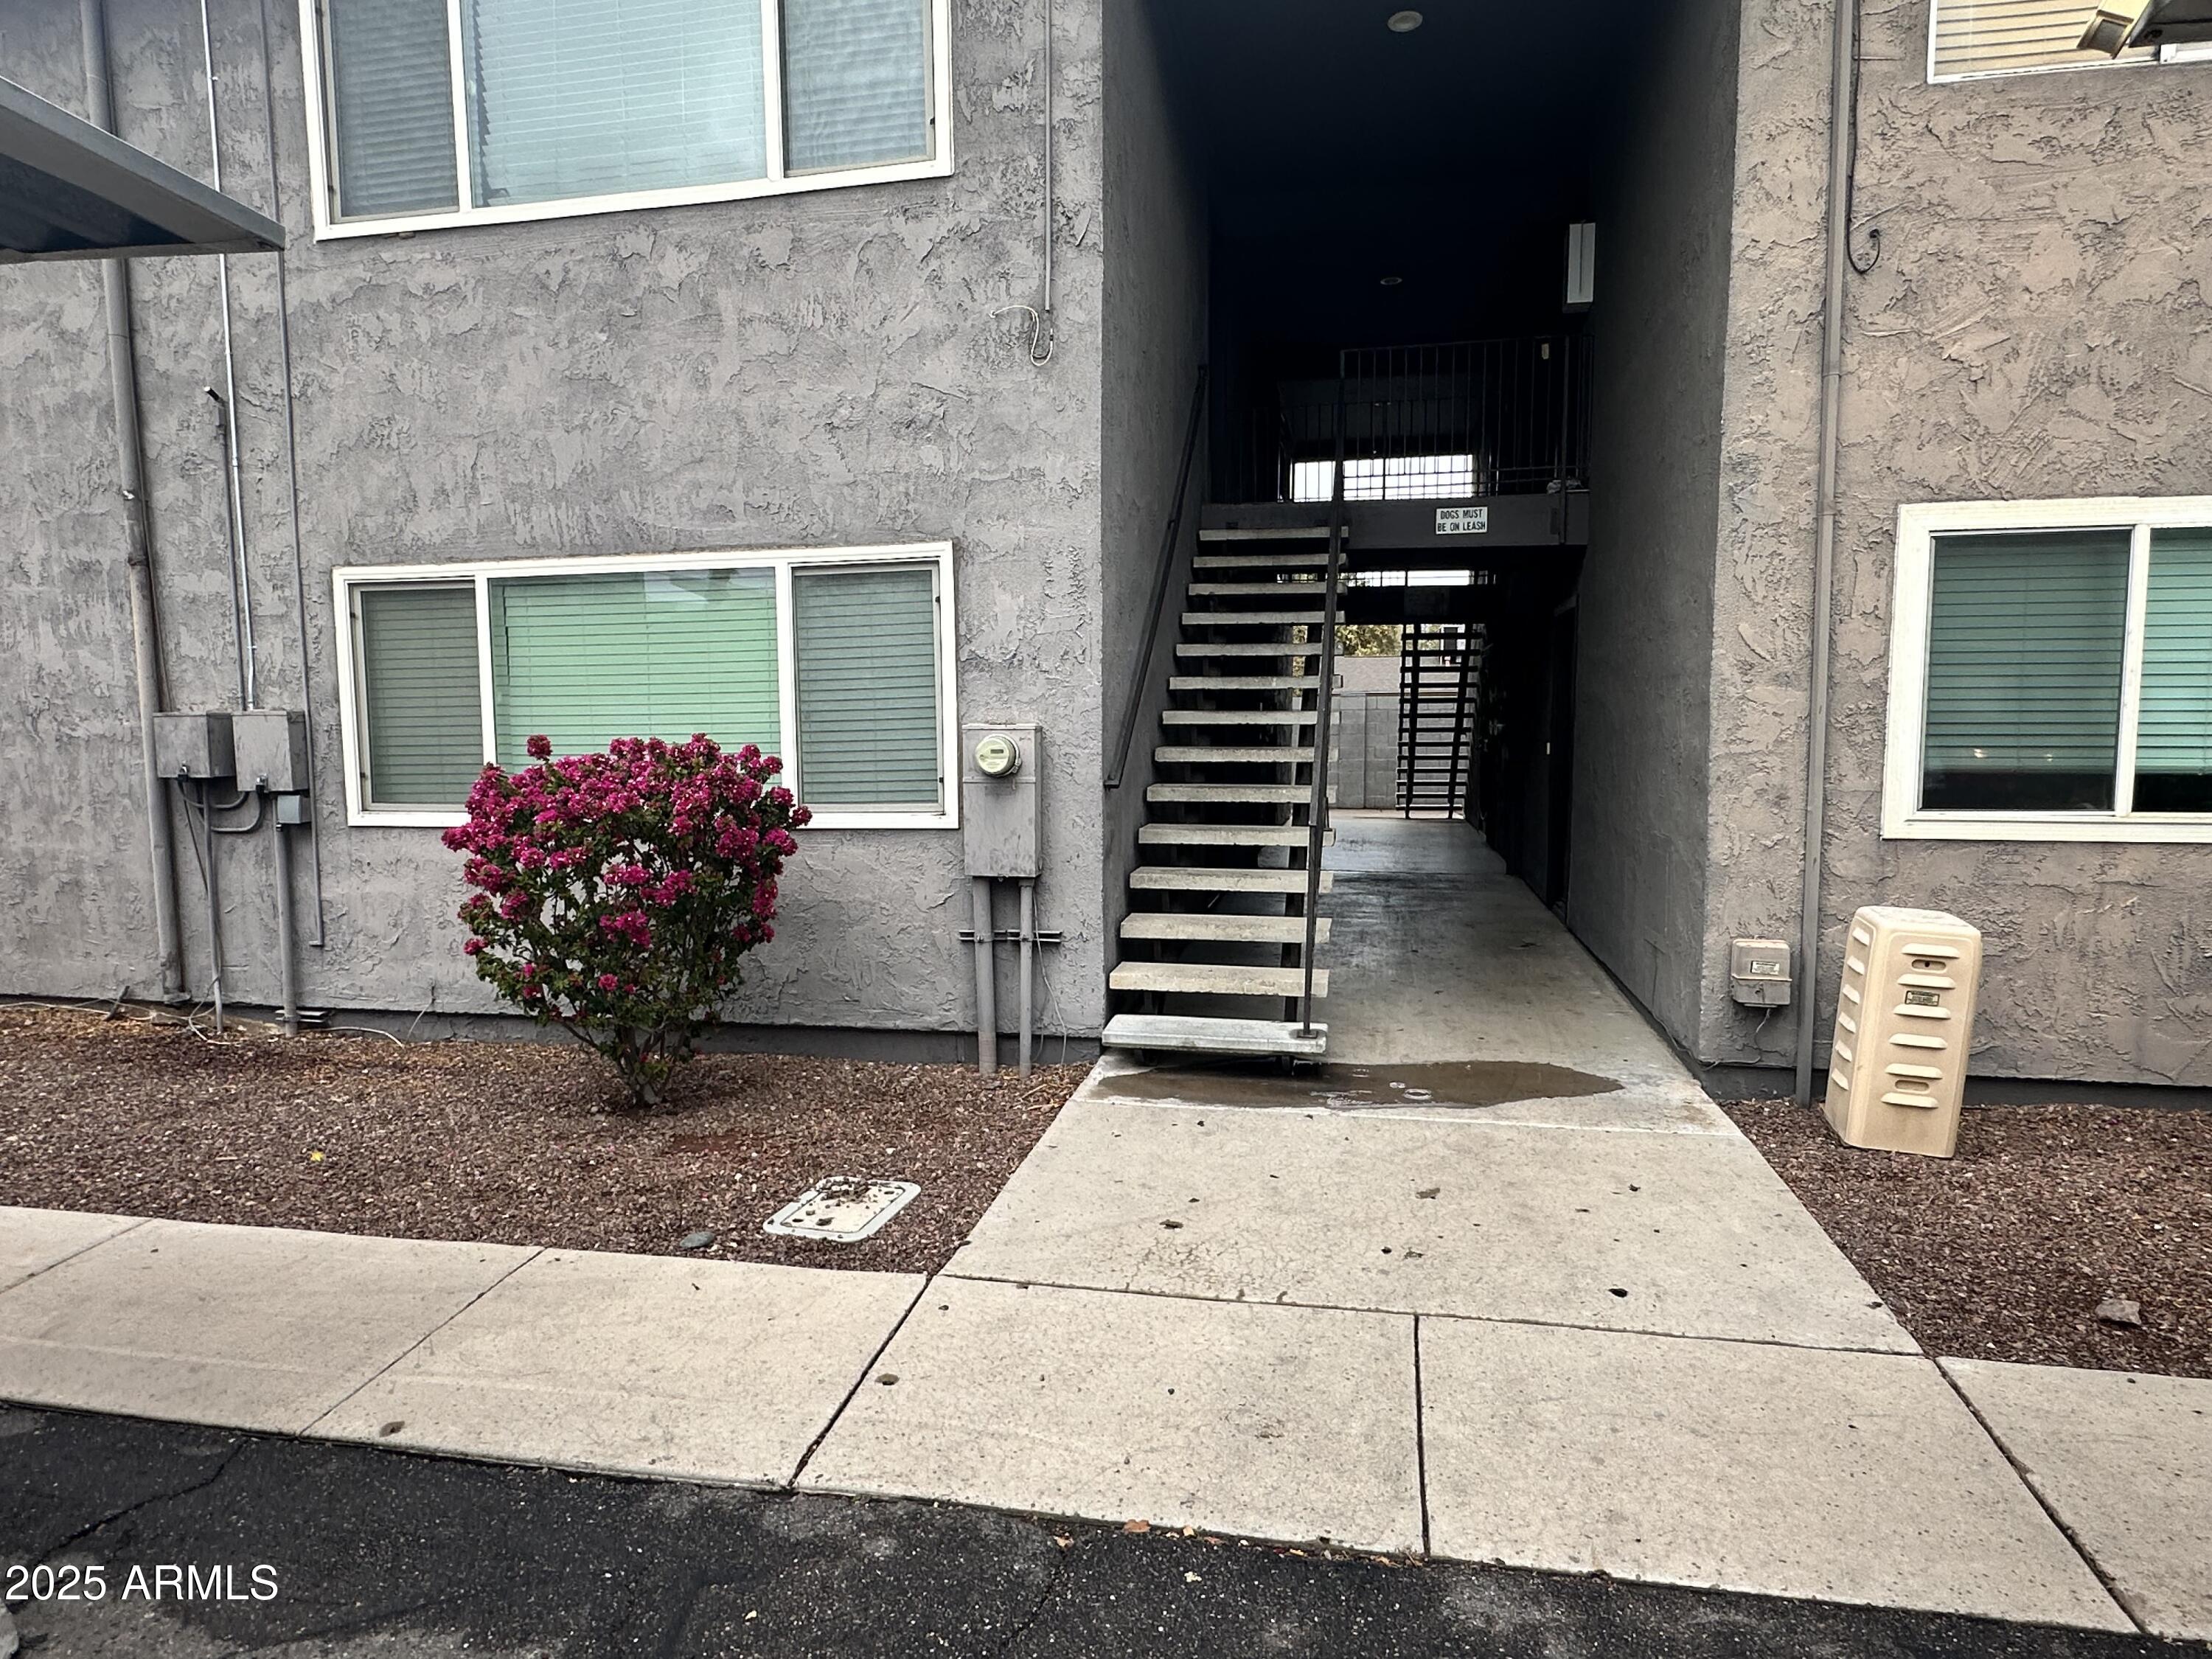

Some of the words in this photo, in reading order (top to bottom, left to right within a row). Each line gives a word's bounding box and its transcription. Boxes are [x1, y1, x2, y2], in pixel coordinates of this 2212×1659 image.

[1441, 509, 1459, 519] DOGS
[1463, 509, 1483, 518] MUST
[1438, 523, 1447, 532] BE
[1450, 522, 1460, 532] ON
[1463, 521, 1485, 531] LEASH
